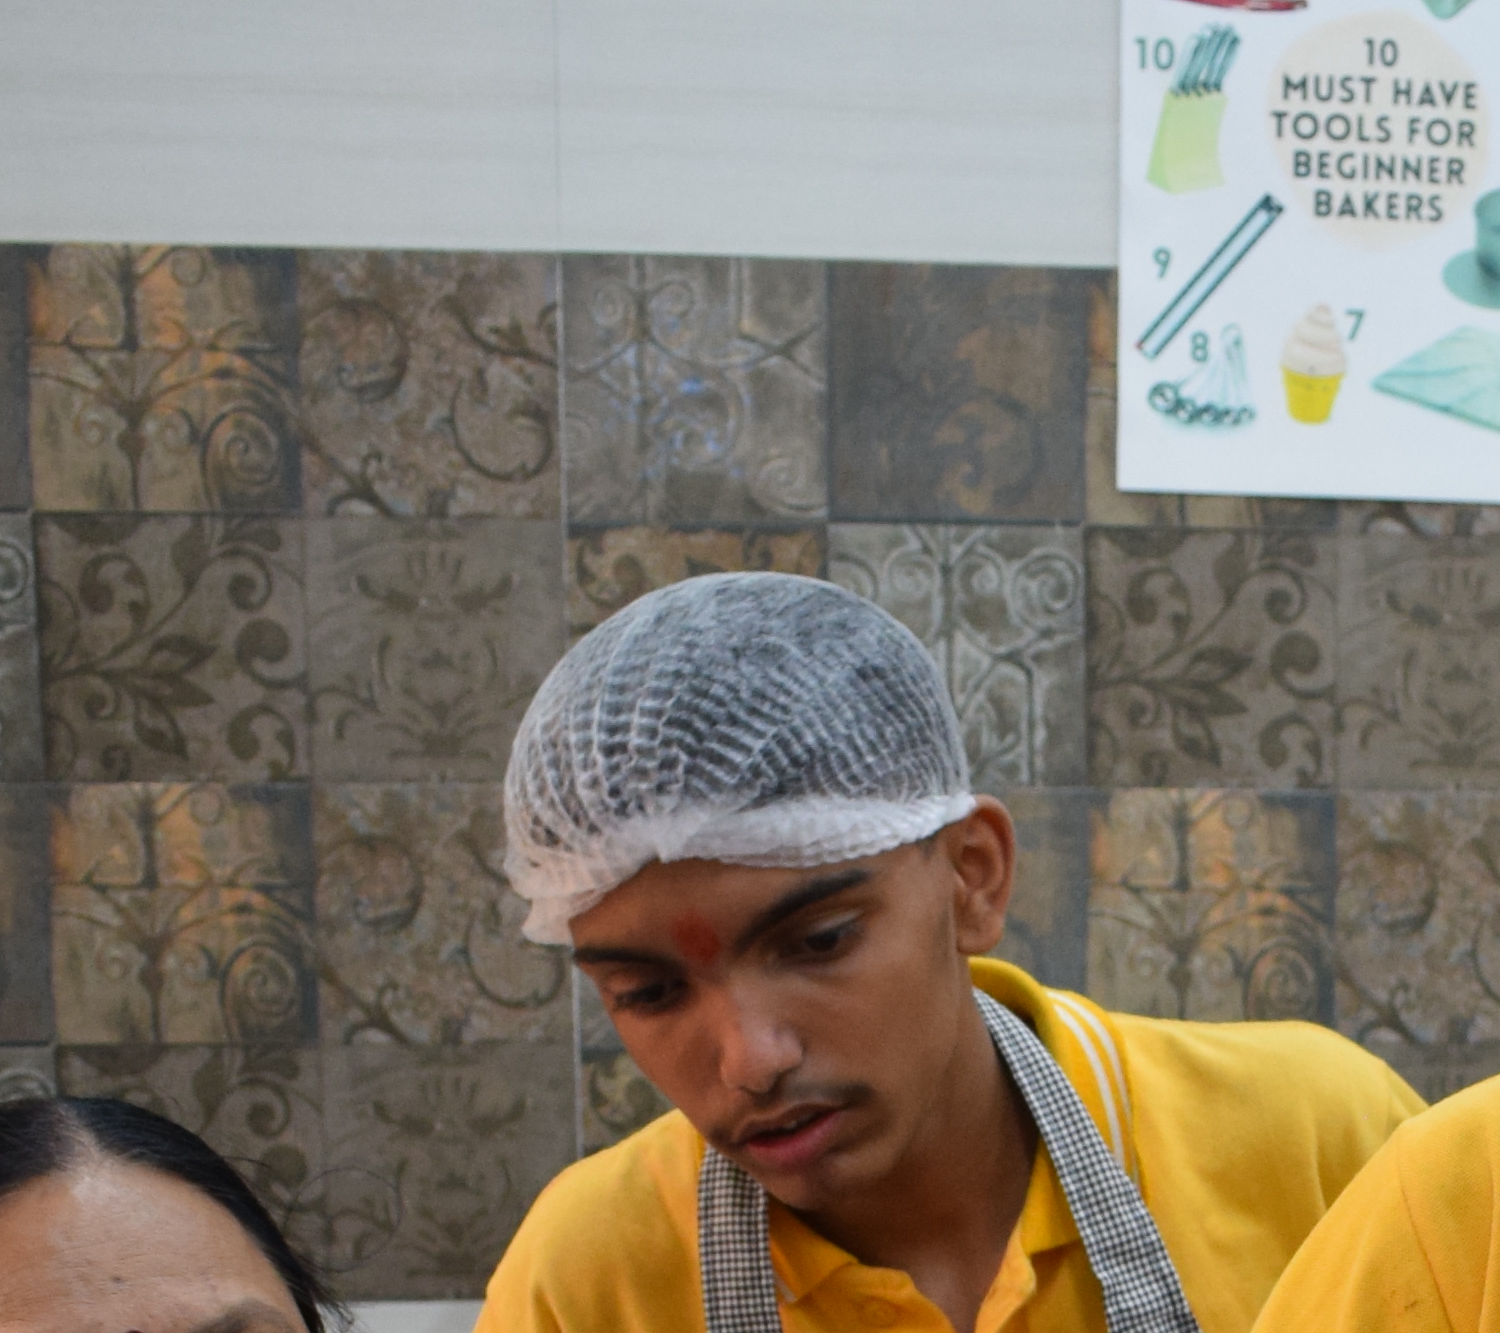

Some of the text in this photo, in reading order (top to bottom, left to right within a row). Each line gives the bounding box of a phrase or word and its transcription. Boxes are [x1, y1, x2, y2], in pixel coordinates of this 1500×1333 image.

[1134, 38, 1175, 71] 10
[1363, 38, 1399, 68] 10
[1281, 74, 1479, 111] MUST HAVE
[1271, 111, 1477, 149] TOOLS FOR
[1292, 150, 1466, 186] BEGINNER
[1313, 190, 1446, 223] BAKERS
[1153, 247, 1172, 279] 9
[1344, 310, 1367, 341] 7
[1190, 331, 1209, 363] 8
